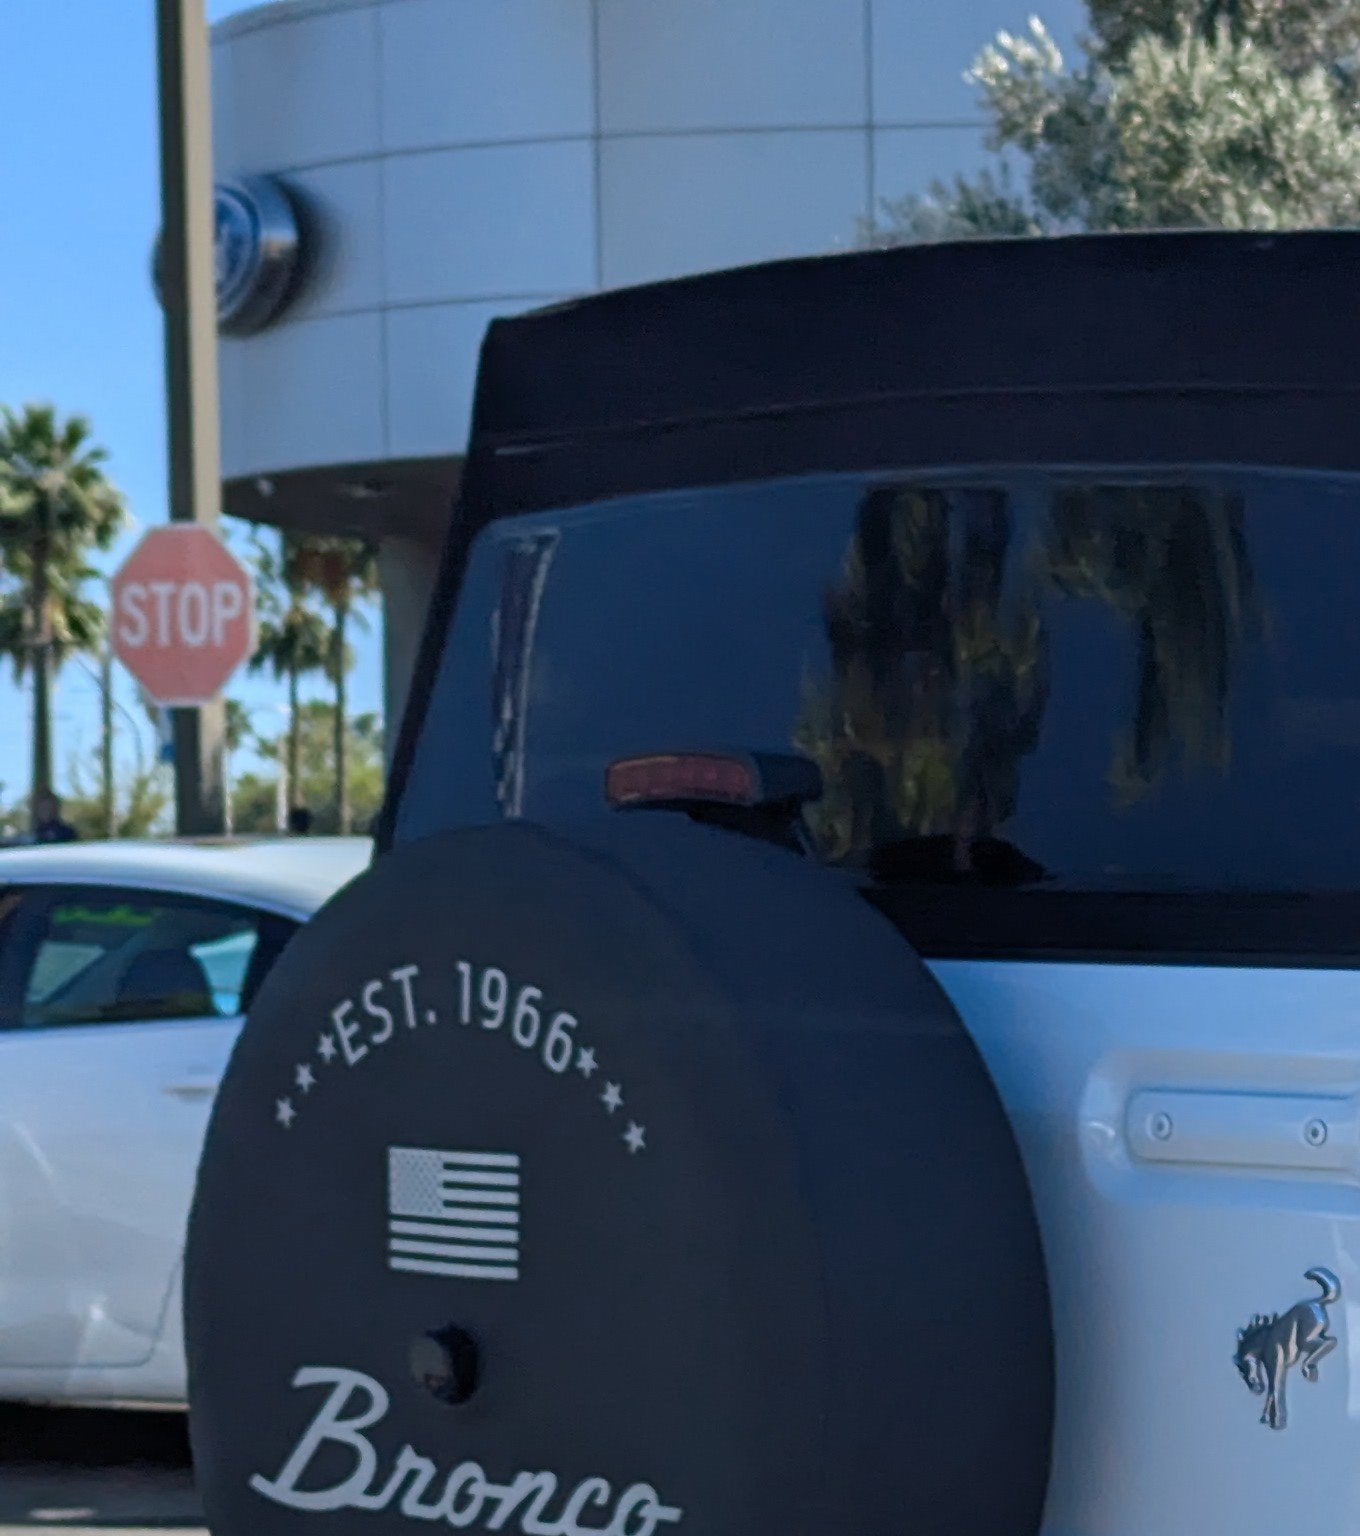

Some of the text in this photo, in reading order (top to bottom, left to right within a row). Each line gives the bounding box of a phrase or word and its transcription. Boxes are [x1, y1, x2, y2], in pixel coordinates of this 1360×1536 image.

[119, 581, 243, 648] STOP
[330, 960, 579, 1074] EST. 1966
